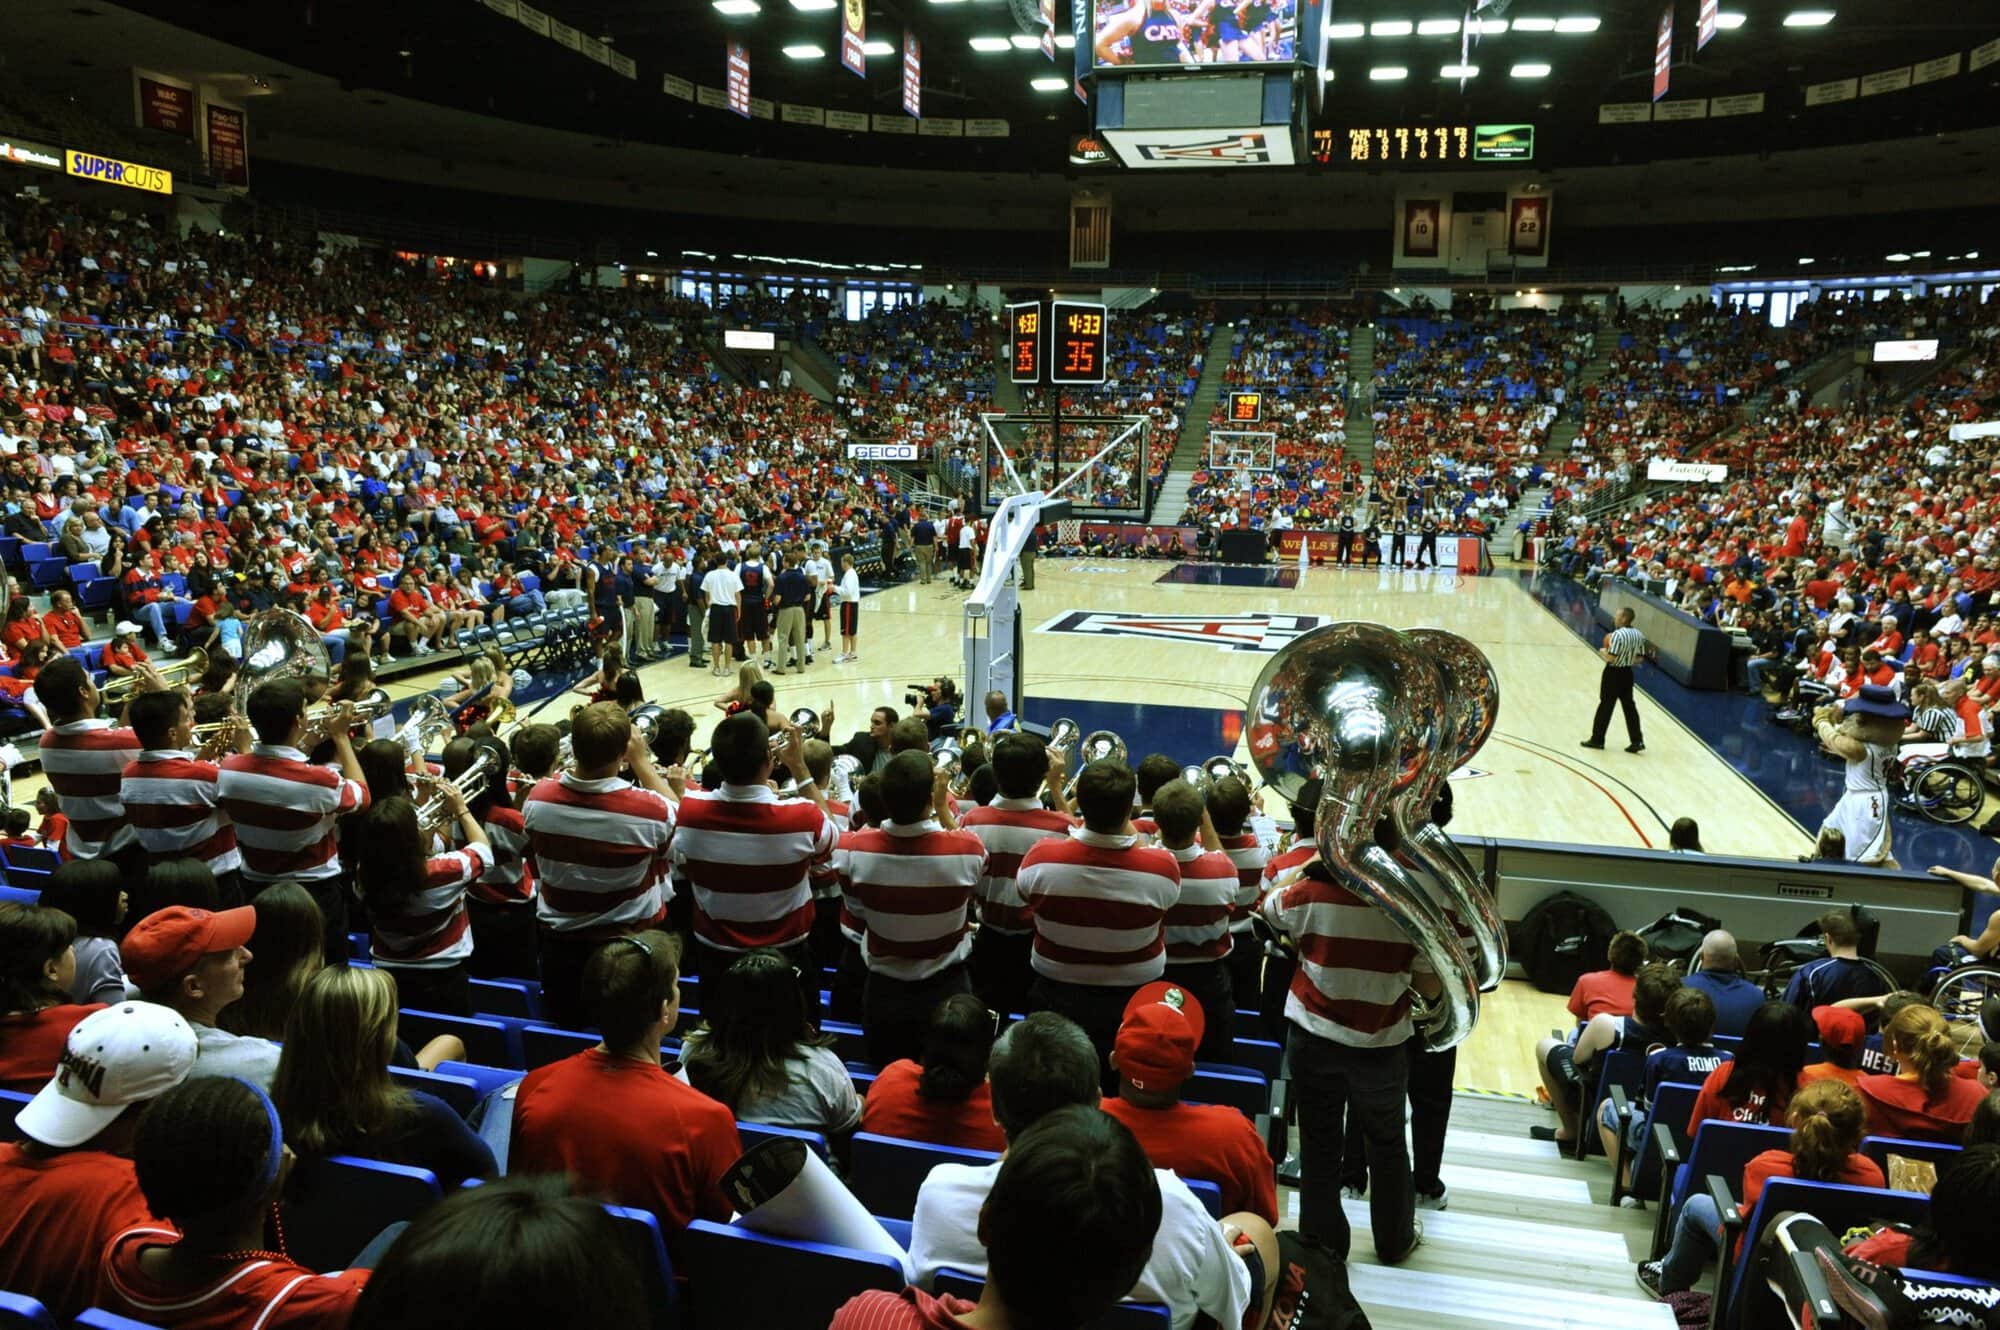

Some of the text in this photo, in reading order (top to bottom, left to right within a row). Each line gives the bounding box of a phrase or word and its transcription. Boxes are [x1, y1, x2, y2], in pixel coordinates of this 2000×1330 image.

[73, 153, 164, 190] SUPERCUTS
[1520, 222, 1536, 233] 22
[1069, 314, 1101, 335] 4:33
[1065, 342, 1094, 371] 35
[1236, 406, 1254, 418] 35
[855, 446, 912, 457] GEICO
[1283, 540, 1328, 551] WELS
[1687, 1056, 1721, 1072] ROMO
